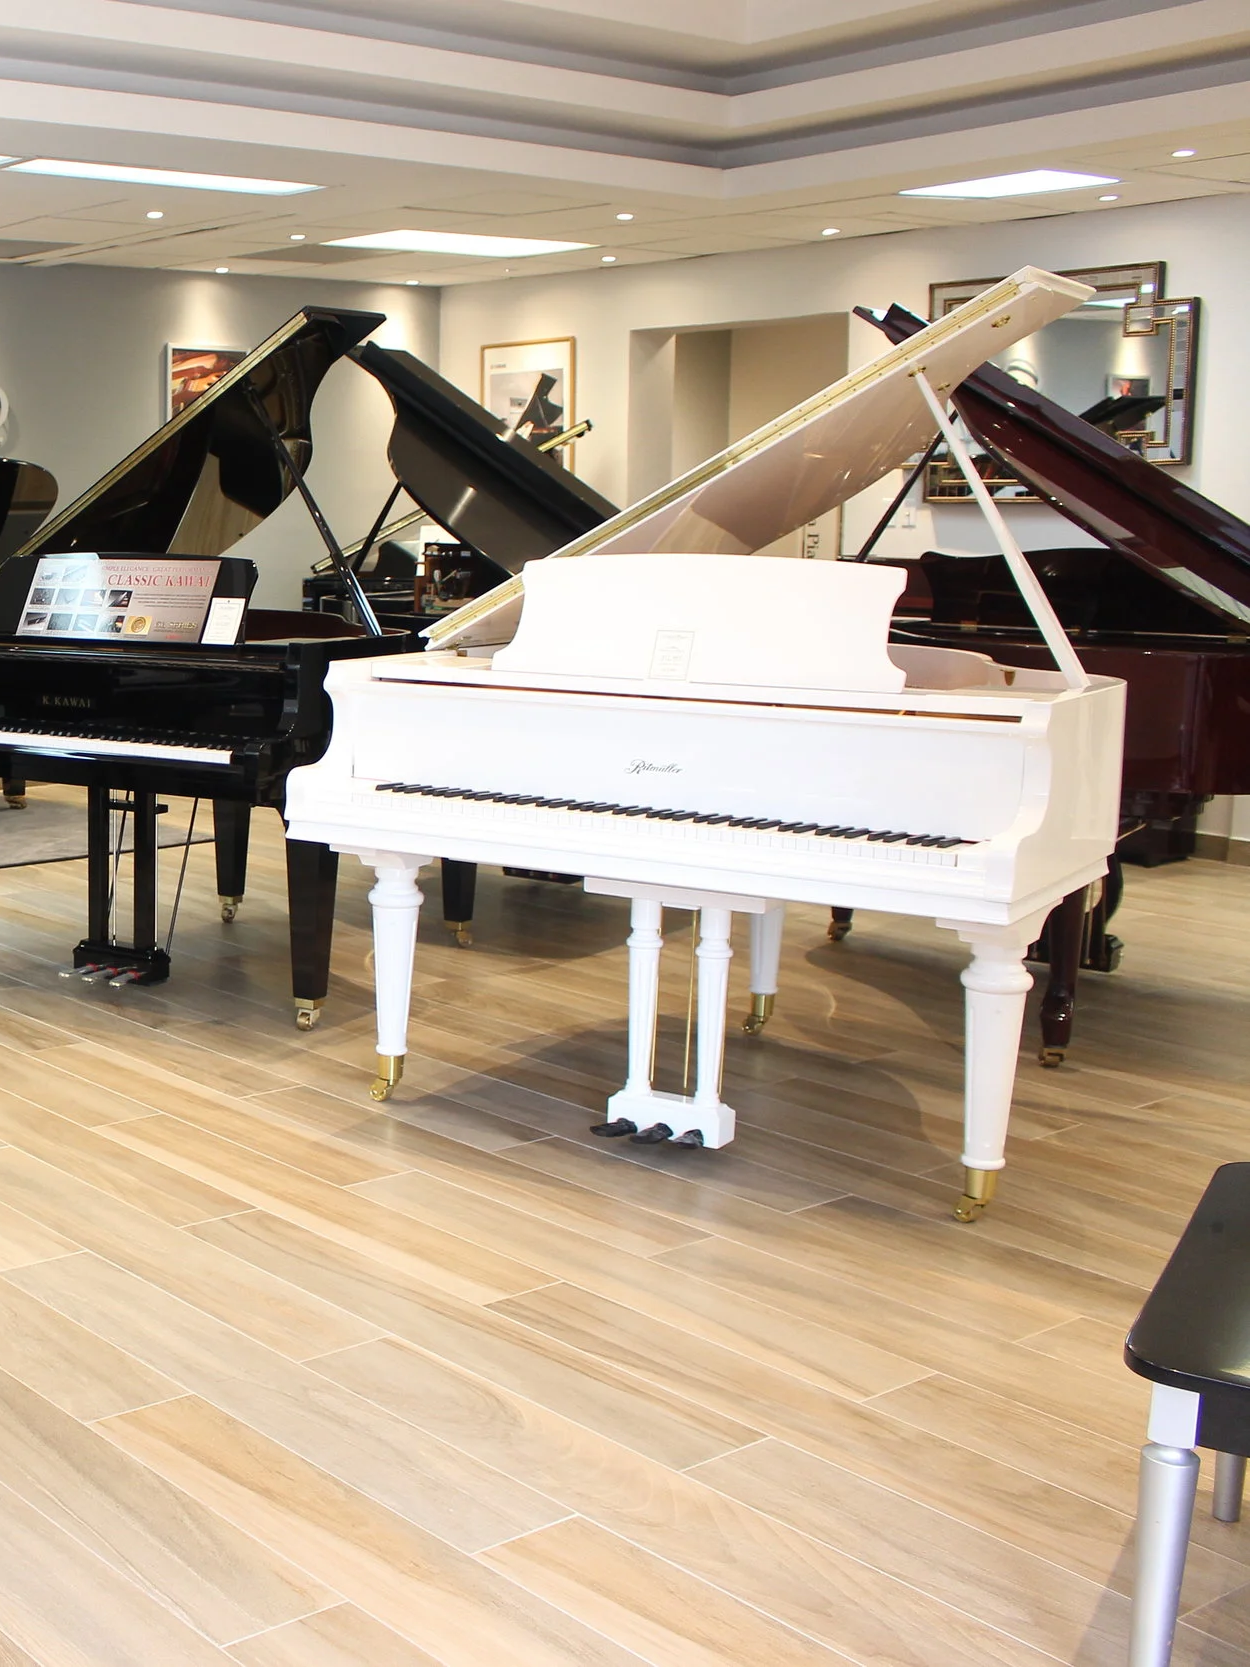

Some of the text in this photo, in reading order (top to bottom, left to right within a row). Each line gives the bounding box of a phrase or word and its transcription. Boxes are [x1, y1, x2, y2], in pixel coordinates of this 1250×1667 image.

[107, 574, 211, 588] CLASSIC KAWAI
[54, 696, 91, 709] KAWAI
